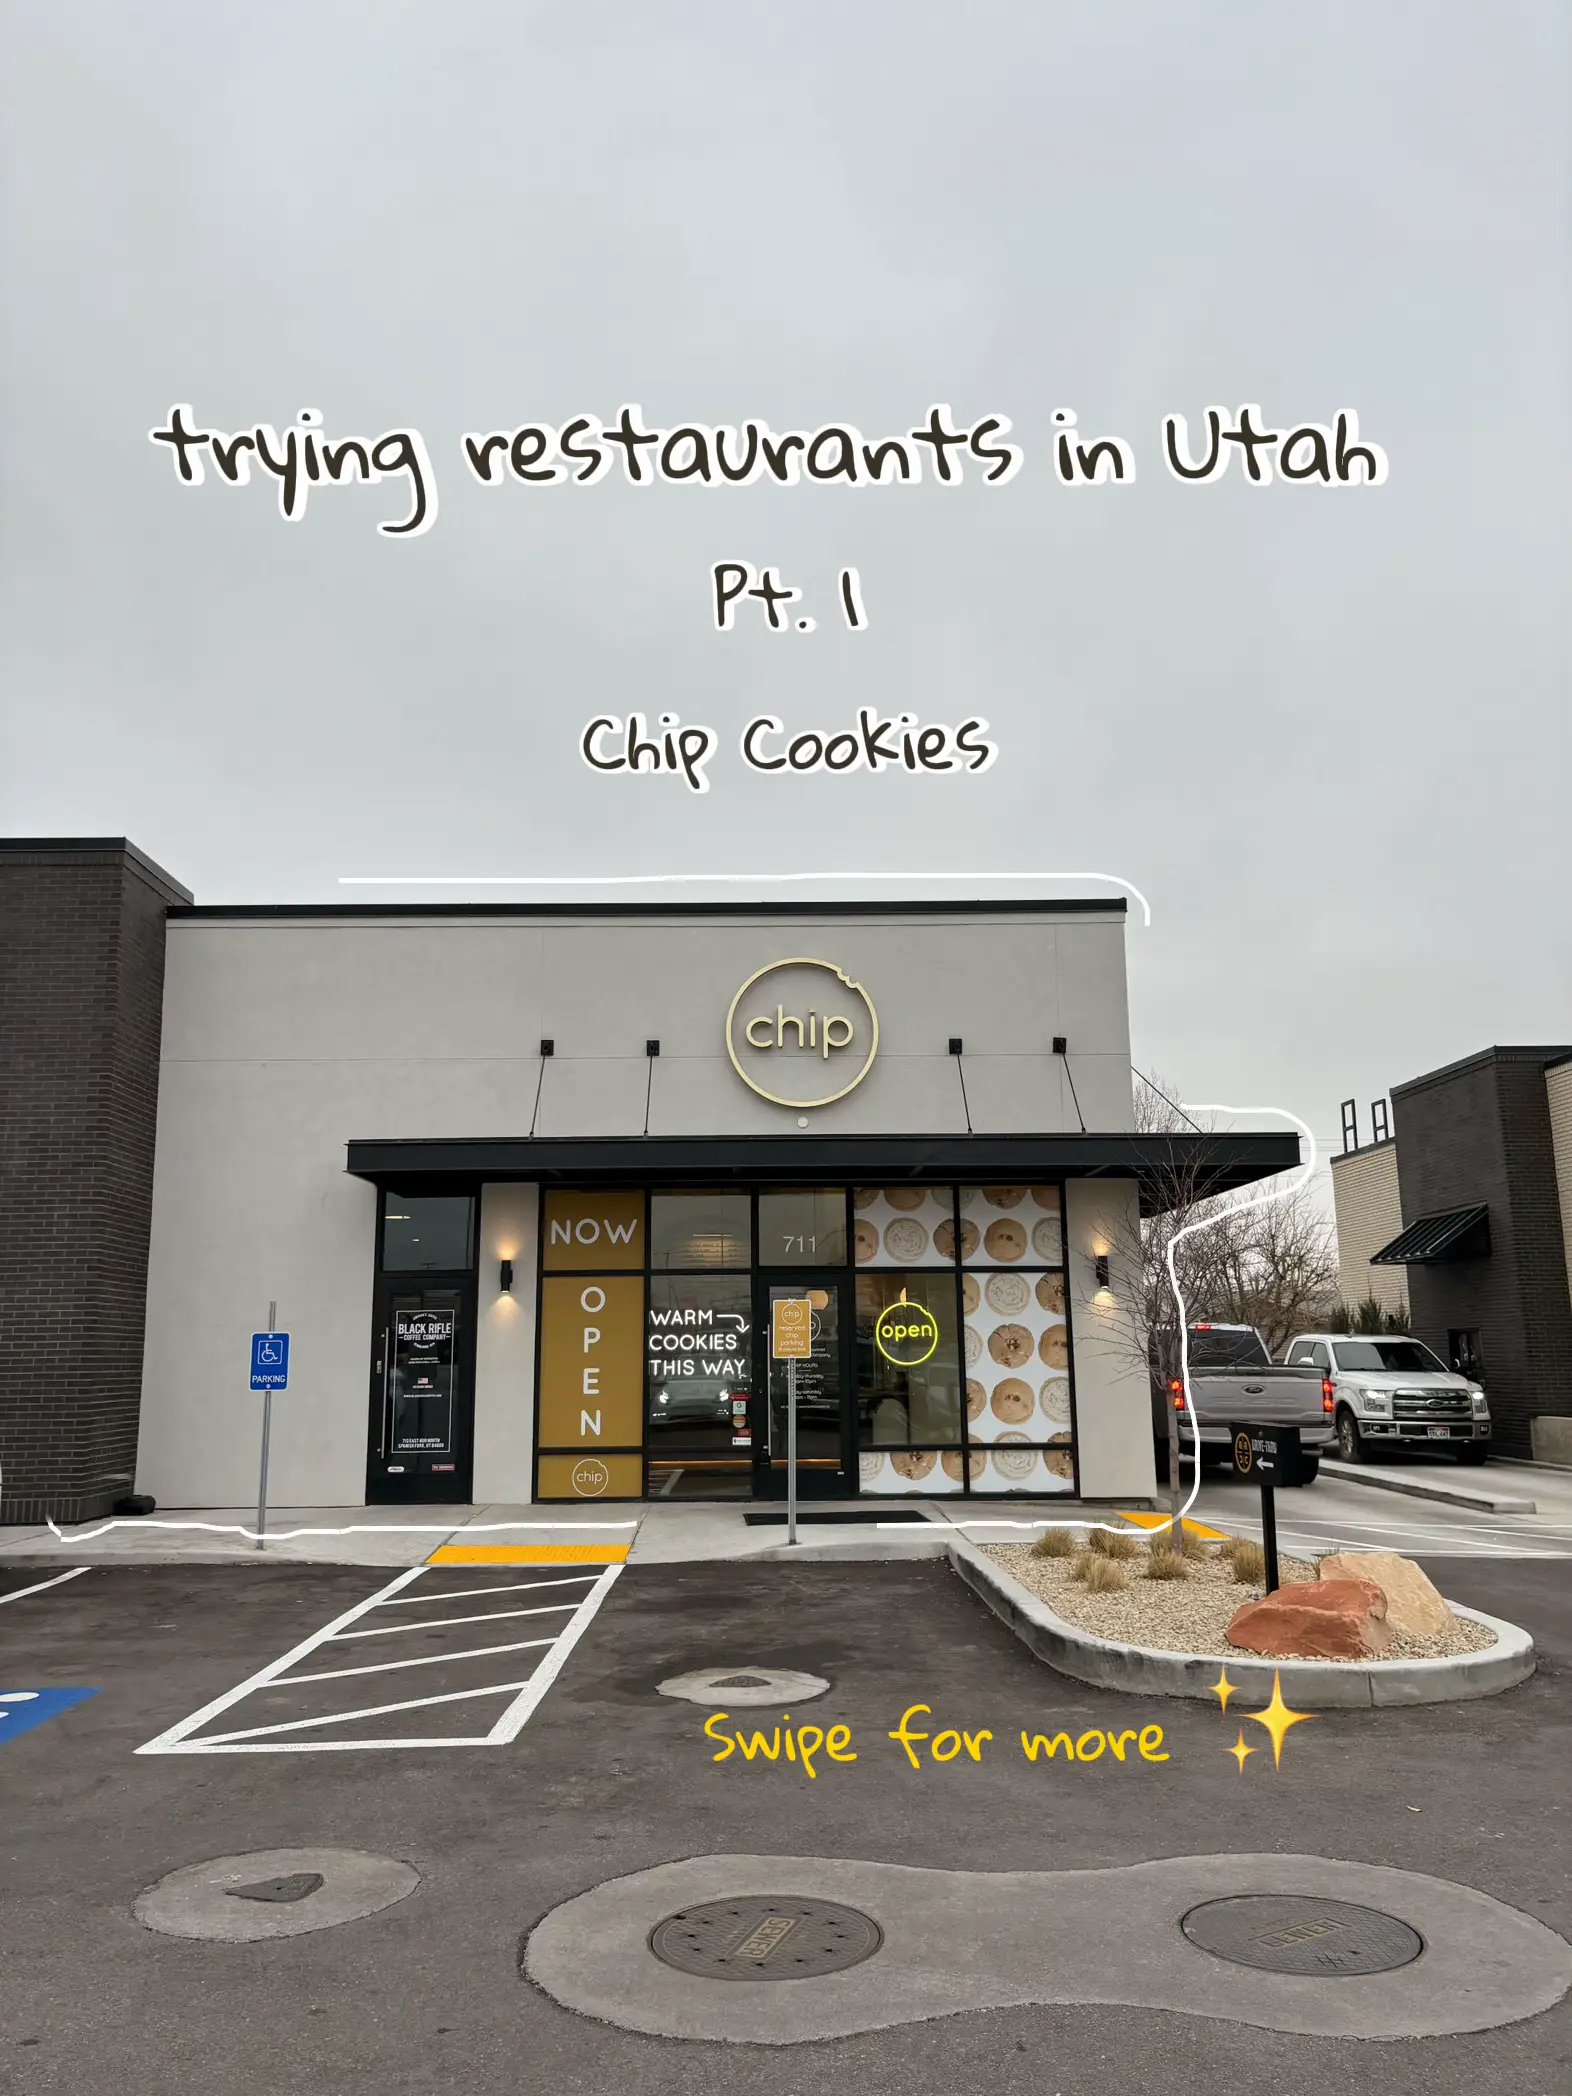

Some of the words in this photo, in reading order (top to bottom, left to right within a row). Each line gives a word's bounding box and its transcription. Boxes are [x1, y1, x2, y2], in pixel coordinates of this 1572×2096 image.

[746, 1004, 854, 1060] chip
[551, 1218, 637, 1245] NOW
[782, 1235, 818, 1253] 711
[650, 1309, 713, 1326] WARM
[784, 1311, 800, 1319] chip
[398, 1323, 427, 1335] BLACK
[428, 1322, 452, 1334] RIFLE
[422, 1333, 447, 1341] COMPANY
[881, 1321, 933, 1342] open
[649, 1333, 737, 1351] COOKIES
[580, 1286, 606, 1437] OPEN
[650, 1359, 695, 1376] THIS
[701, 1358, 746, 1376] WAY
[251, 1375, 286, 1384] PARKING
[576, 1471, 604, 1484] chip
[743, 1917, 791, 1957] SEWER
